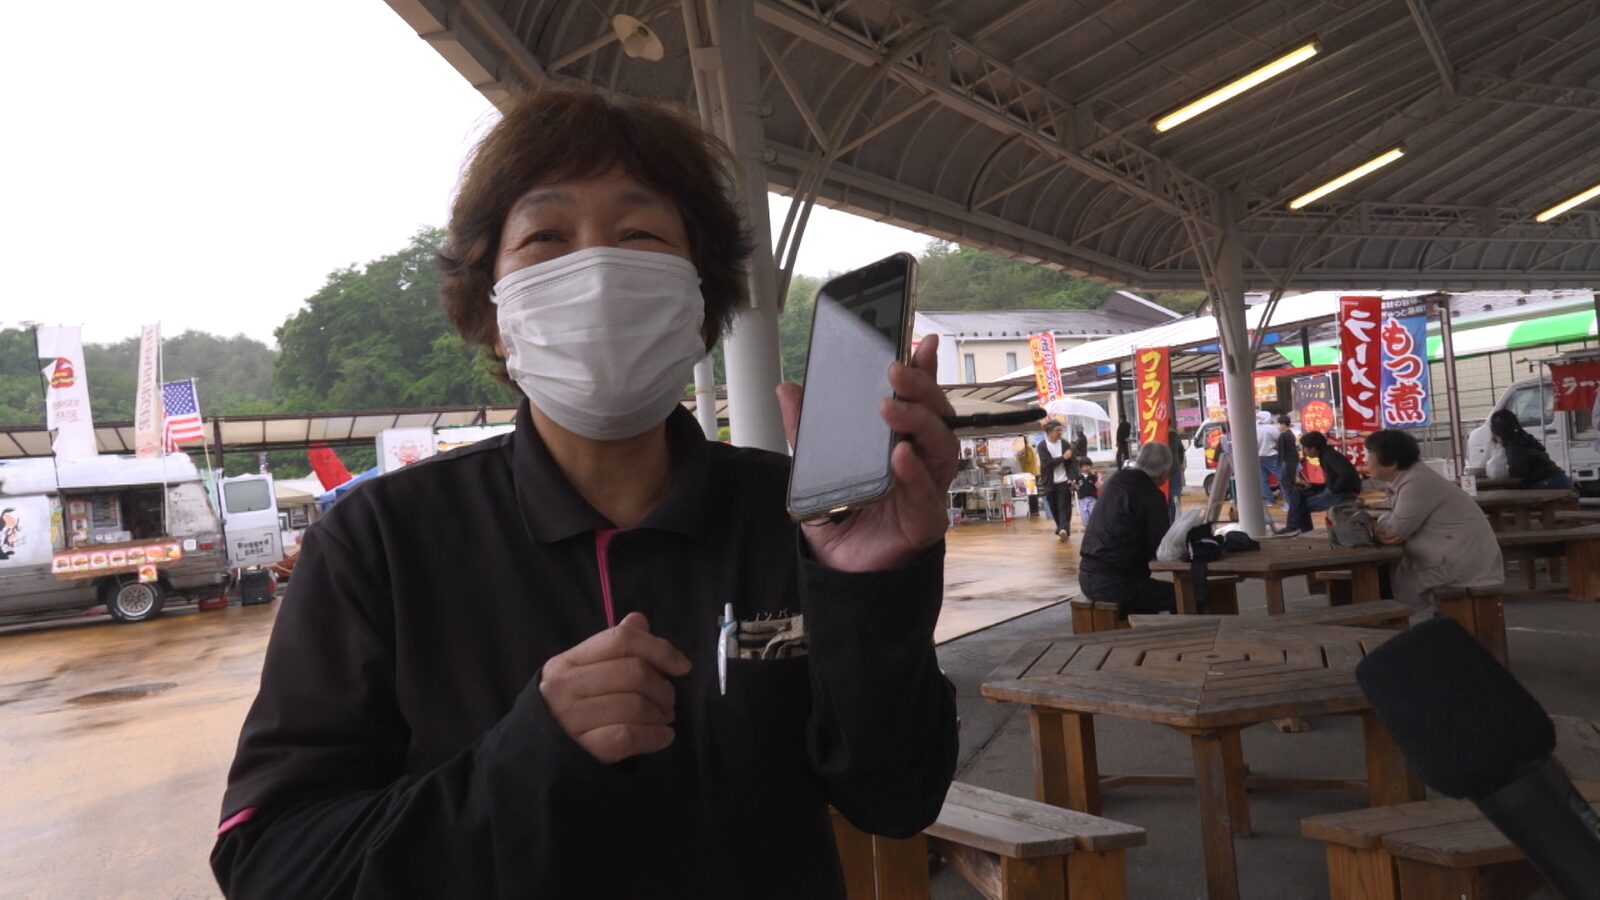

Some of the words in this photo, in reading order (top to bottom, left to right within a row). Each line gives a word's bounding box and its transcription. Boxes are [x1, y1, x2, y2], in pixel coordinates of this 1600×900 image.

[1141, 351, 1161, 442] フランク
[1382, 318, 1425, 423] もつ煮
